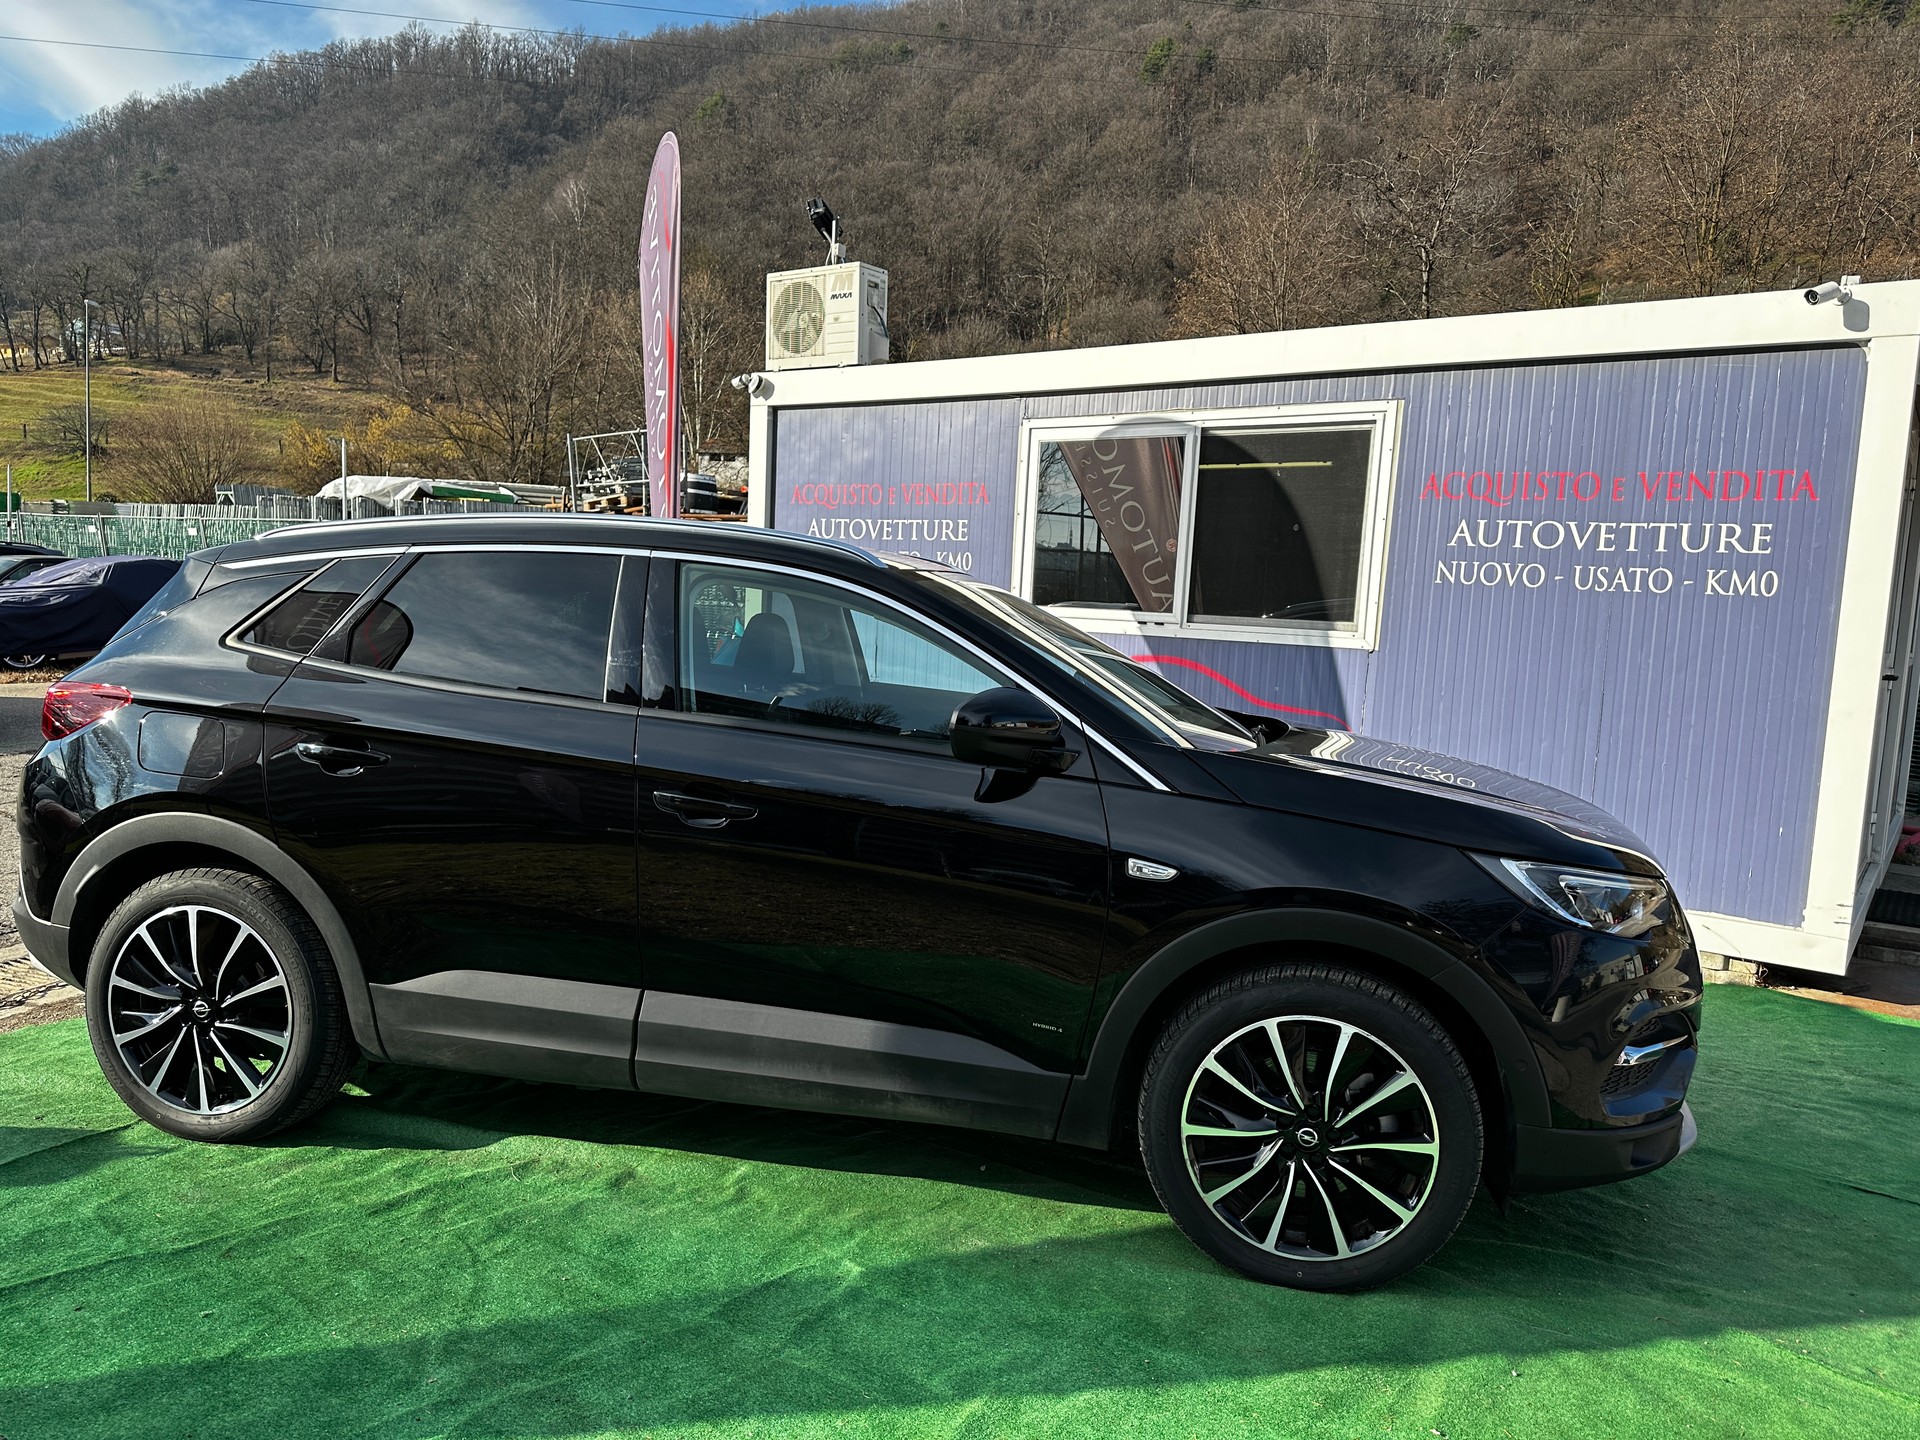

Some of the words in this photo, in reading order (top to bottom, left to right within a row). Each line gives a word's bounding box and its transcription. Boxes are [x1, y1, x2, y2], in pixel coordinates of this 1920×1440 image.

[830, 292, 852, 300] MAXA
[791, 483, 882, 509] ACQUISTO
[902, 482, 990, 505] VENDITA
[1419, 471, 1601, 507] ACQUISTO
[1638, 470, 1819, 501] VENDITA
[807, 518, 968, 541] AUTOVETTURE
[1447, 519, 1773, 554] AUTOVETTURE
[1434, 560, 1545, 588] NUOVO
[1573, 565, 1673, 593] USATO
[1704, 568, 1778, 597] KM0
[1032, 1022, 1057, 1031] HYBRID
